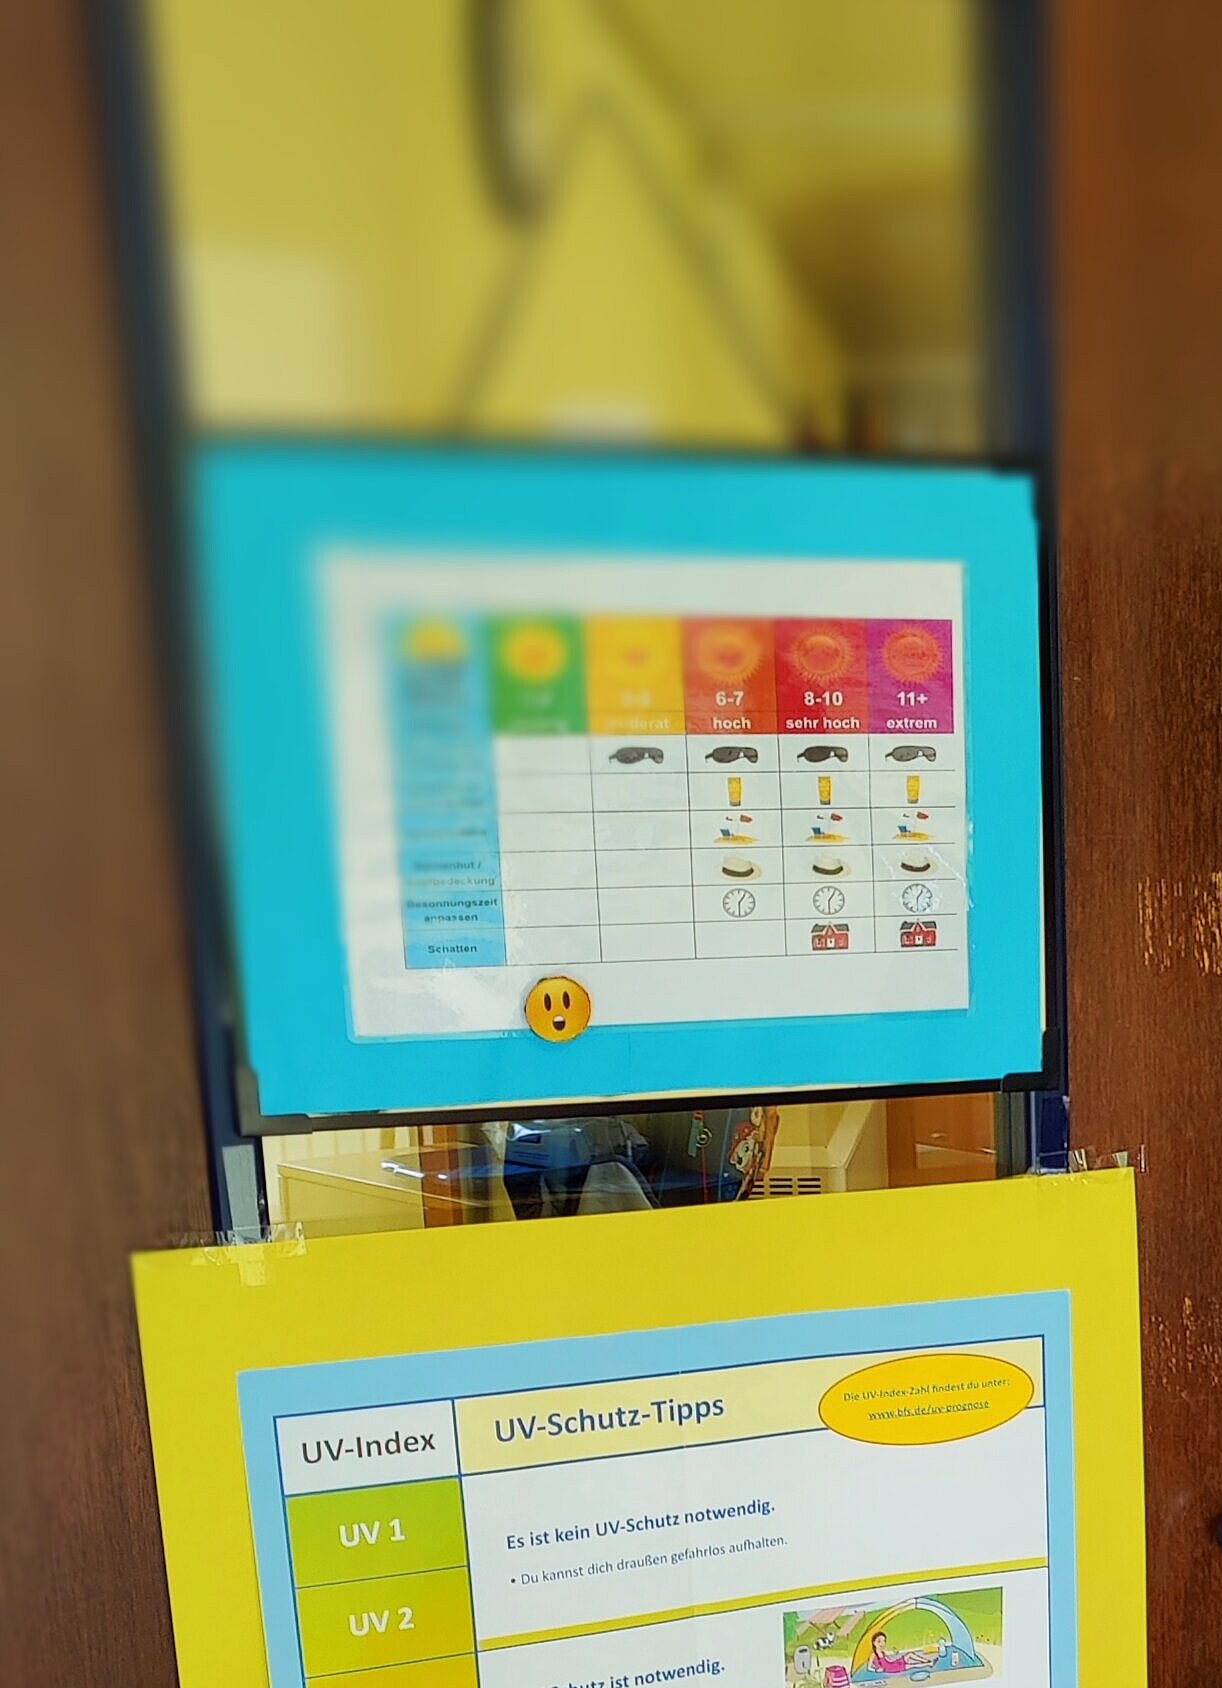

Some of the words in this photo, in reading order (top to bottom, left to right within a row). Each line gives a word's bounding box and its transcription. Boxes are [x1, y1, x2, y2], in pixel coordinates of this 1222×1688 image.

[716, 692, 744, 707] 6-7
[804, 691, 843, 707] 8-10
[897, 692, 928, 706] 11+
[713, 717, 751, 730] hoch
[786, 718, 819, 730] sehr
[823, 716, 860, 730] hoch
[886, 718, 937, 730] extrem
[428, 944, 478, 955] Schatten
[495, 1398, 724, 1442] UV-Schutz-Tipps
[302, 1430, 435, 1463] UV-Index
[339, 1521, 379, 1547] UV
[389, 1519, 406, 1541] 1
[506, 1535, 524, 1549] Es
[529, 1531, 549, 1546] ist
[554, 1525, 590, 1542] kein
[595, 1514, 679, 1536] UV-Schutz
[684, 1499, 774, 1523] notwendig.
[520, 1573, 538, 1584] Du
[542, 1566, 583, 1582] kannst
[587, 1561, 613, 1575] dich
[616, 1554, 667, 1570] draußen
[670, 1545, 725, 1564] gefahrlos
[728, 1536, 787, 1553] aufhalten.
[349, 1610, 389, 1637] UV
[397, 1607, 415, 1630] 2
[634, 1658, 724, 1686] notwendig.
